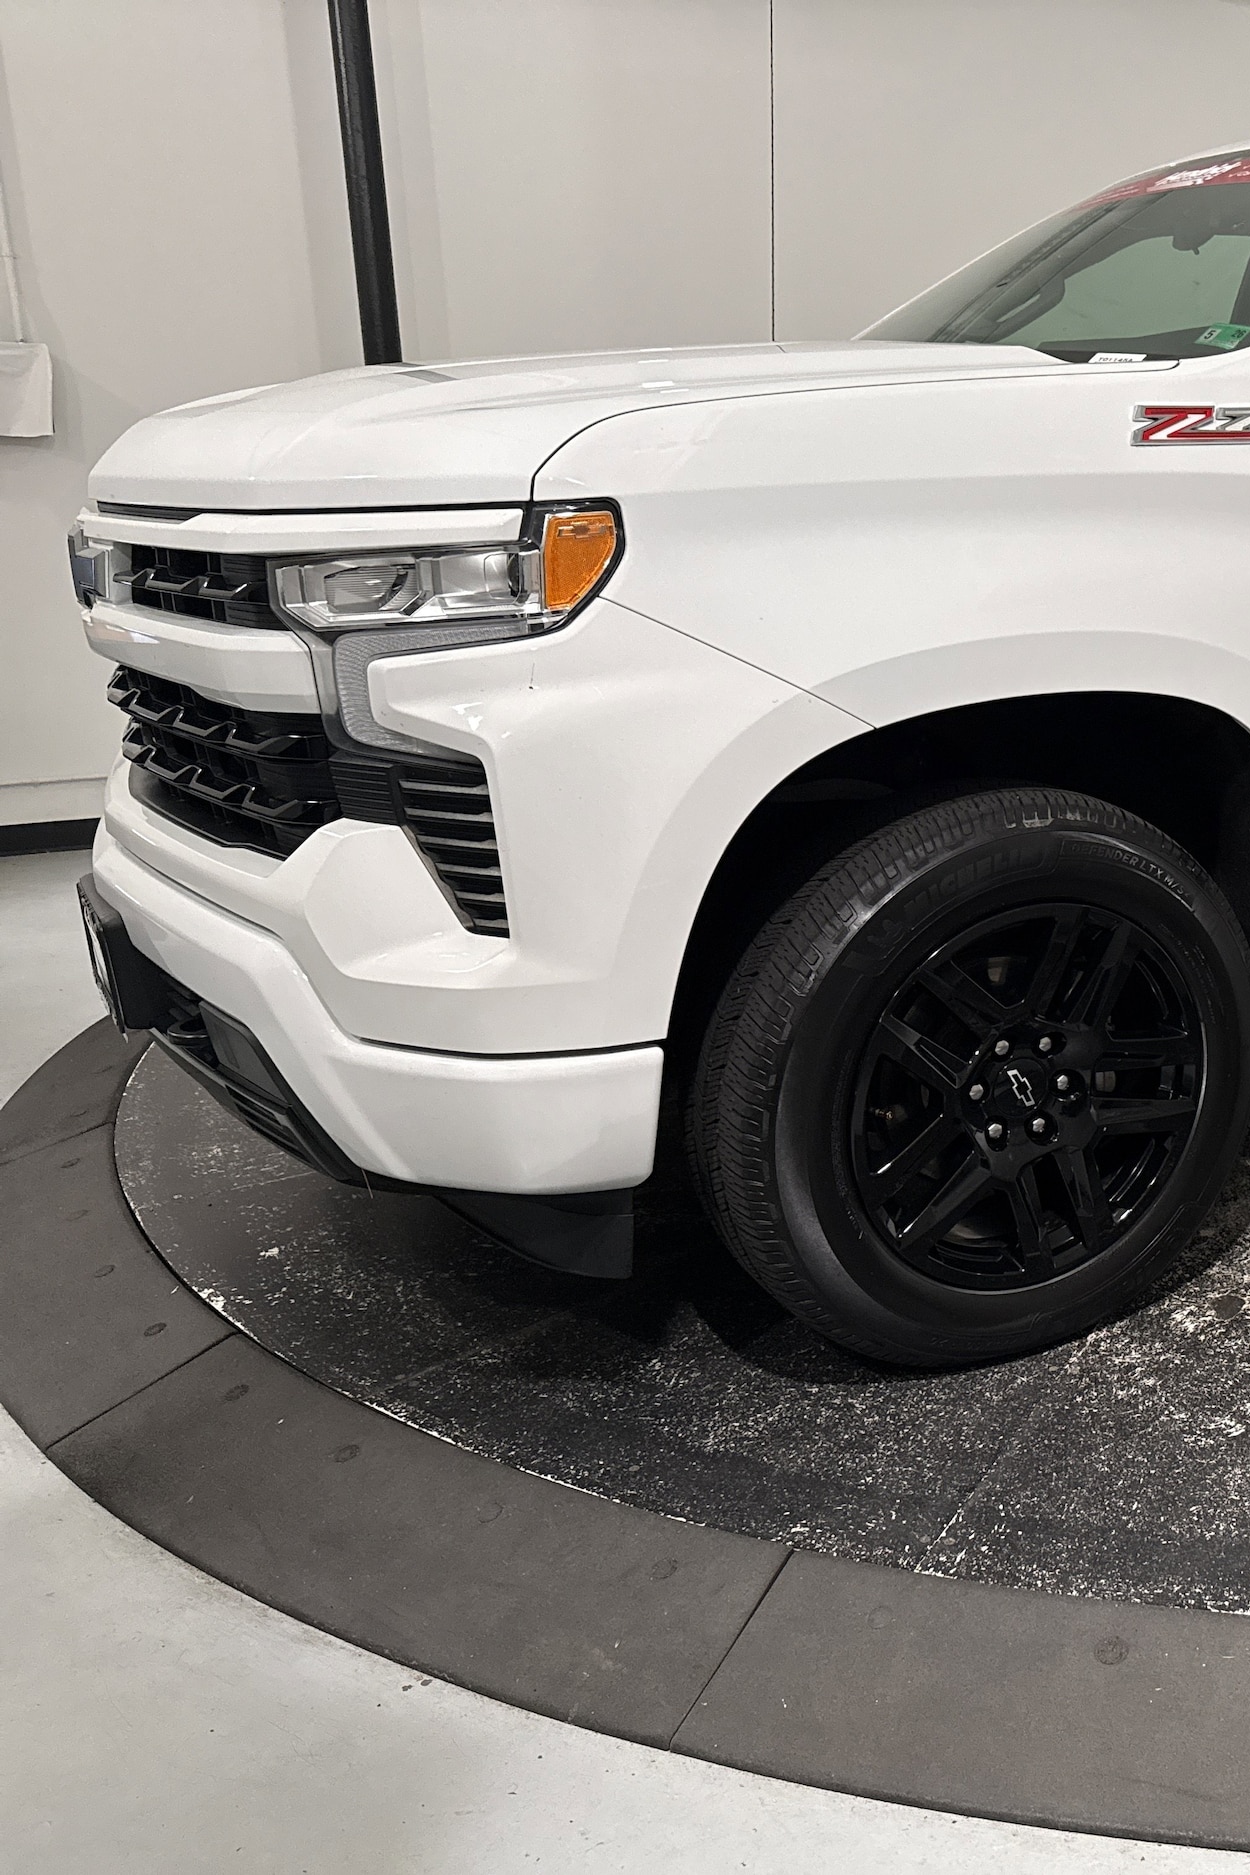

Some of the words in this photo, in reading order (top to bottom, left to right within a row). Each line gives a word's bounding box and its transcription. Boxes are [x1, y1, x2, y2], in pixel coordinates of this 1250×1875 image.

[1204, 330, 1217, 340] 5
[1071, 843, 1138, 867] DEFENDER
[1139, 859, 1164, 880] LTX
